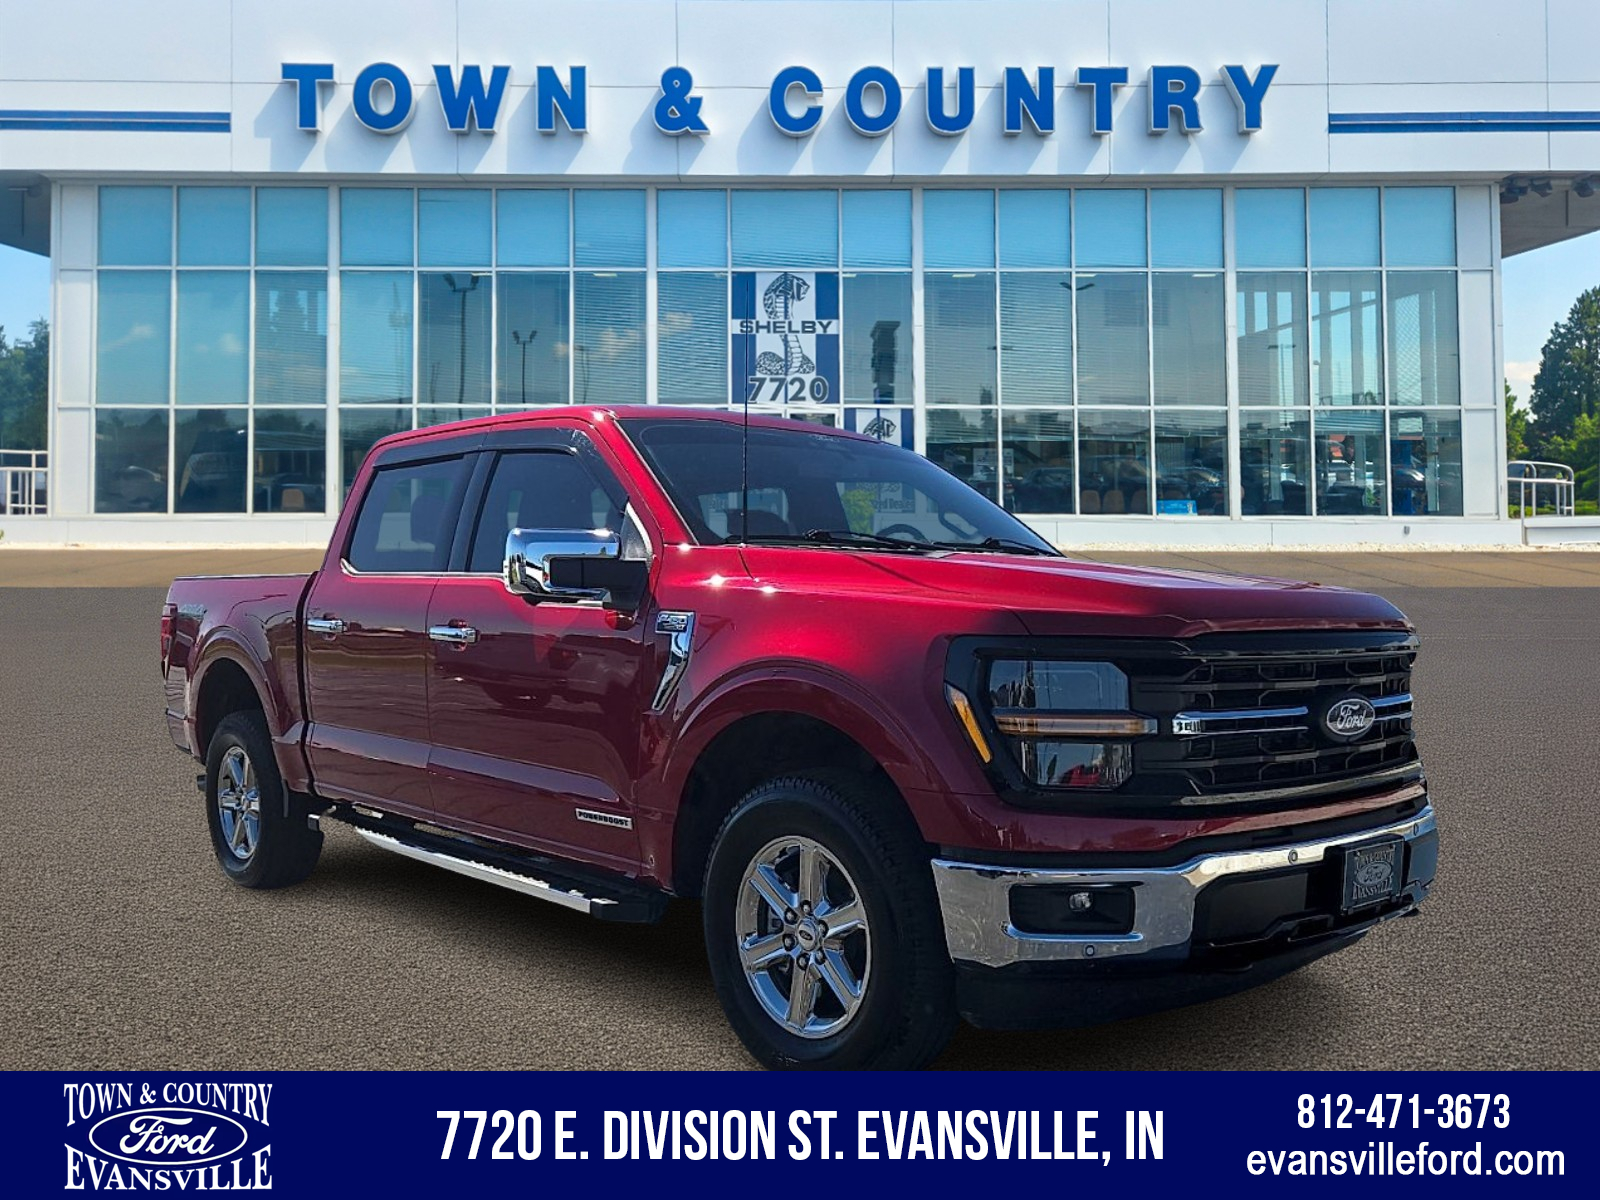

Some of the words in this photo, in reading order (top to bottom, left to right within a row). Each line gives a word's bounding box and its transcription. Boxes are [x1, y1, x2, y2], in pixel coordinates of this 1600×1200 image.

[281, 62, 589, 132] TOWN
[653, 65, 710, 134] &
[768, 63, 1279, 134] COUNTRY
[739, 320, 833, 334] SHELBY
[748, 376, 829, 402] 7720
[1336, 704, 1367, 729] Ford
